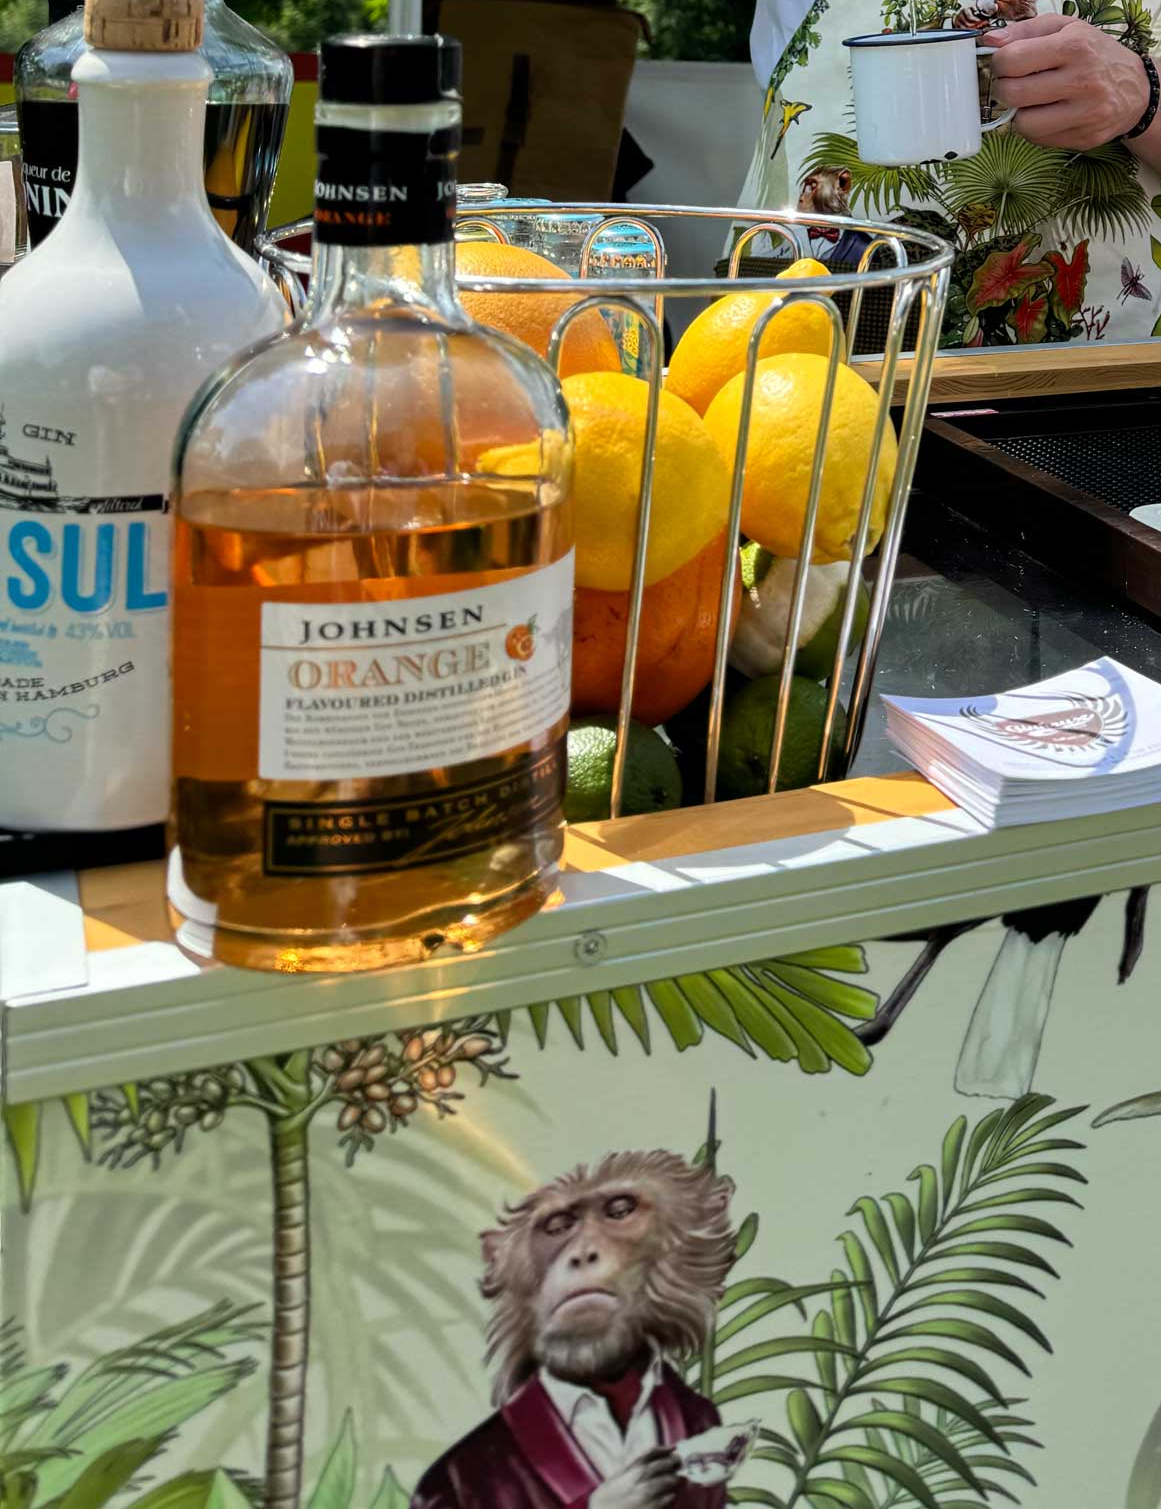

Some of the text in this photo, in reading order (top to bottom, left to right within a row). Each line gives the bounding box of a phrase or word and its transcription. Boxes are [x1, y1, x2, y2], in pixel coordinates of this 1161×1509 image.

[51, 166, 71, 182] de
[22, 423, 77, 446] GIN
[8, 520, 168, 613] SUL
[300, 605, 485, 645] JOHNSEN
[0, 677, 44, 688] ADE
[16, 660, 135, 702] HAMBURG
[288, 641, 491, 691] ORANGE
[284, 692, 400, 711] FLAVOURED
[403, 674, 501, 705] DISTILLED
[287, 811, 392, 831] SINGLE
[405, 794, 488, 823] BATCH
